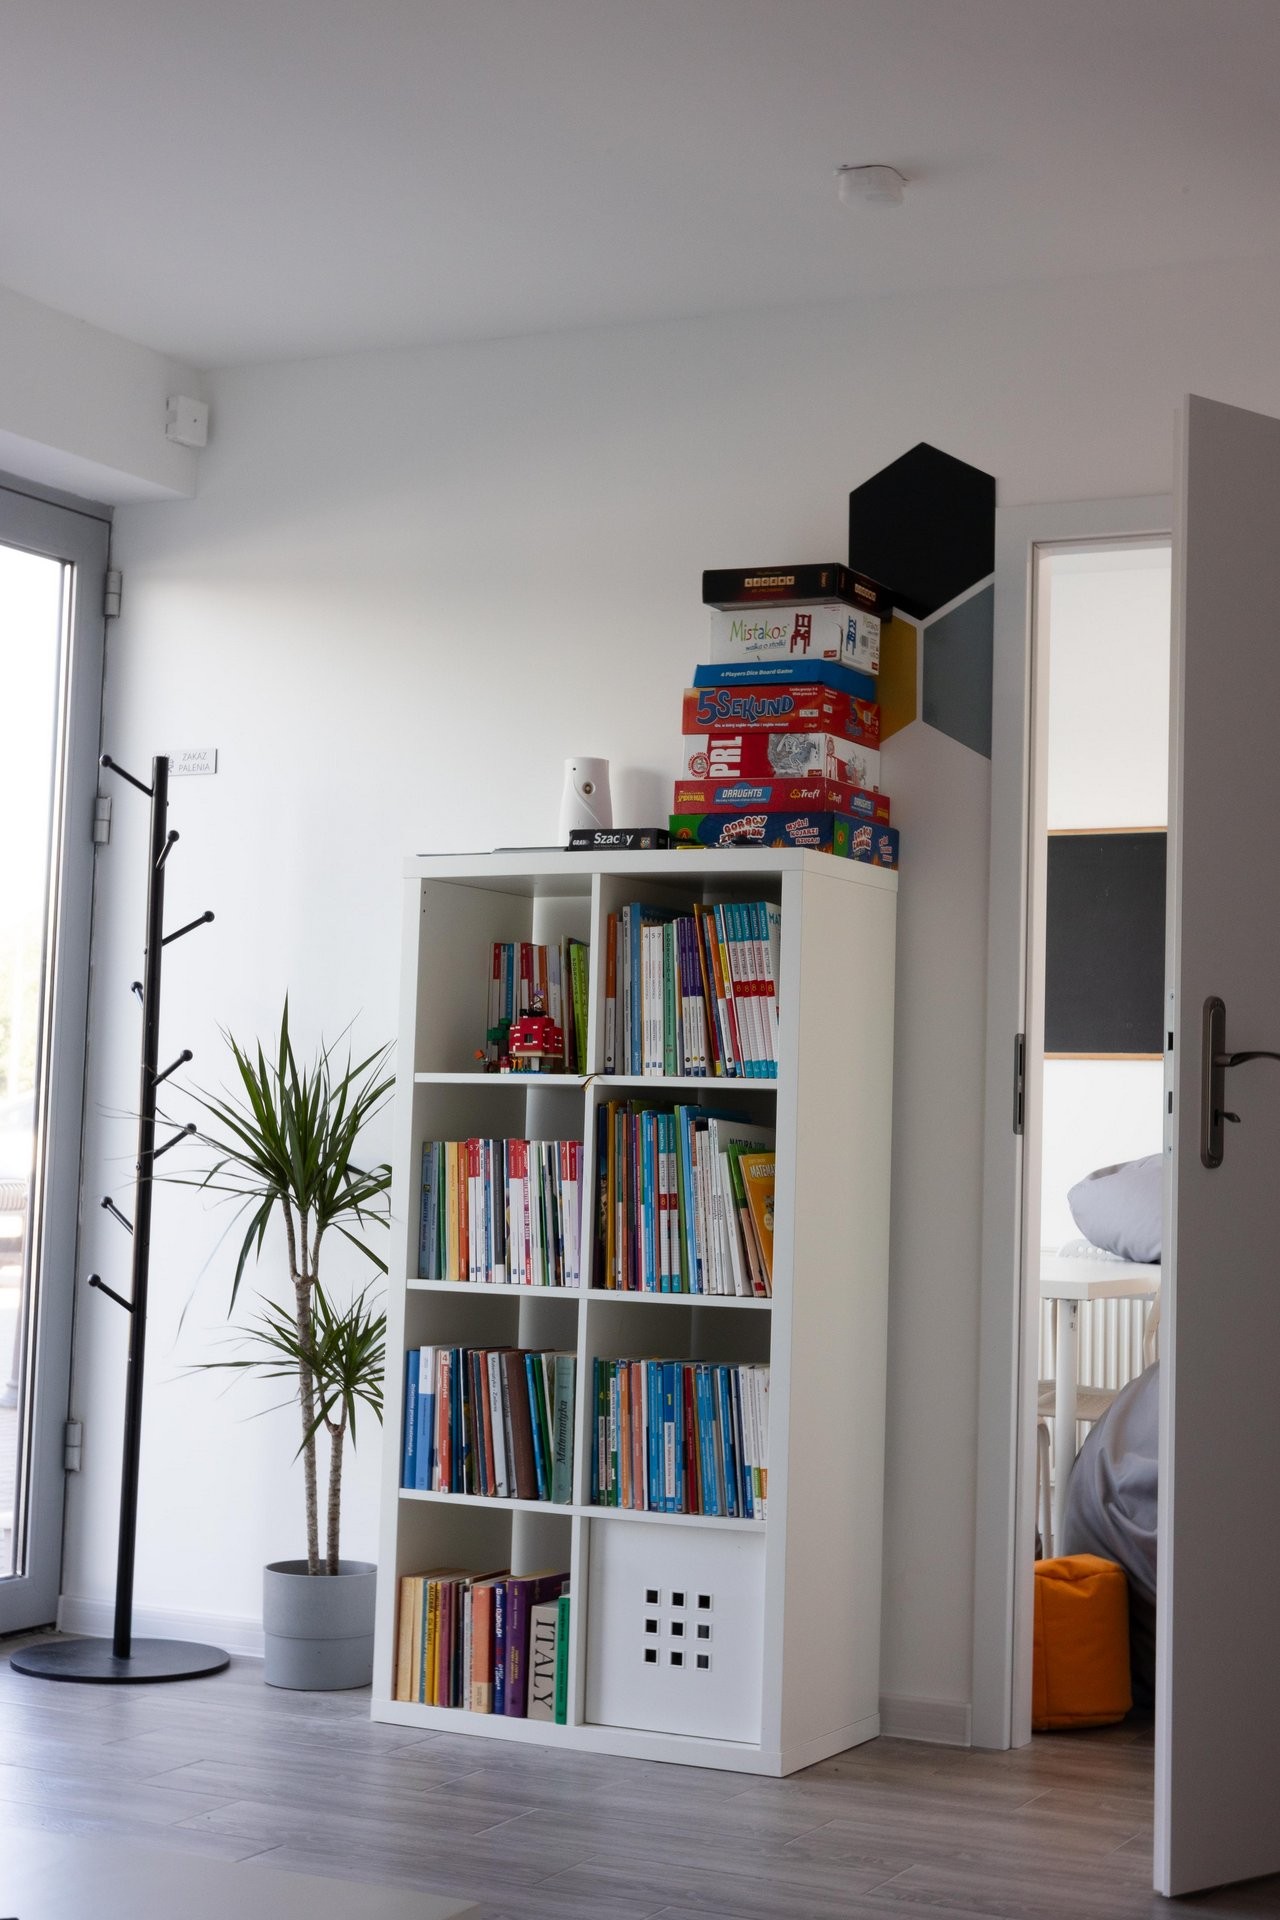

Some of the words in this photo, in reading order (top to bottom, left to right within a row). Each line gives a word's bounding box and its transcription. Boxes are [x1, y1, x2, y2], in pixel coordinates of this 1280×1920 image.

[730, 619, 788, 642] Mistakos
[696, 689, 718, 726] 5
[182, 751, 208, 761] ZAKAZ
[709, 736, 743, 777] PRL
[178, 763, 210, 772] PALENIA
[722, 788, 763, 798] DRAUGHTS
[801, 789, 820, 799] Trefl
[442, 1353, 448, 1362] 4
[556, 1400, 569, 1465] Matematyka
[533, 1619, 556, 1711] ITALY
